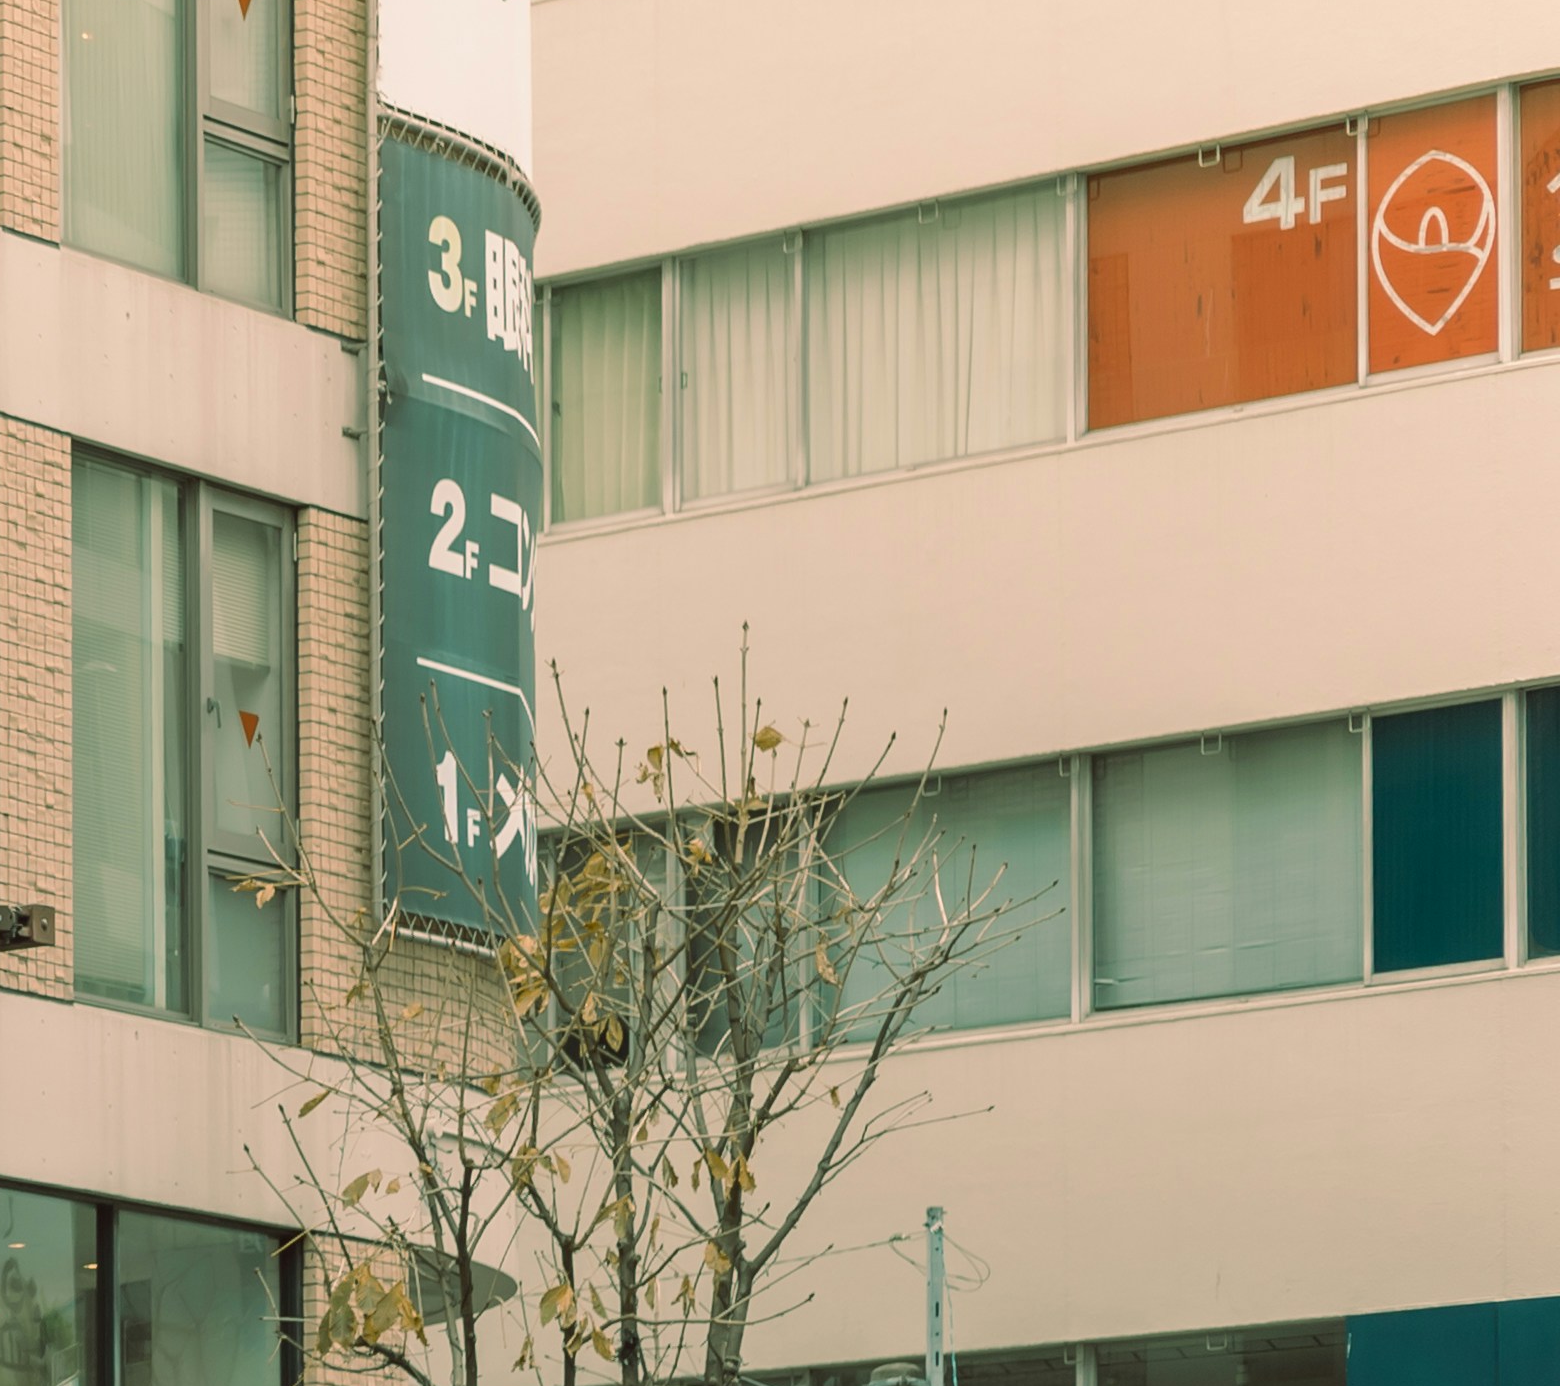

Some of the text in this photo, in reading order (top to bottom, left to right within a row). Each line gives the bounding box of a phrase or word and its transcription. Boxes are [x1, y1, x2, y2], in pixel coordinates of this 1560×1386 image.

[1241, 155, 1348, 231] 4F
[428, 214, 478, 319] 3F
[429, 477, 479, 580] 2F
